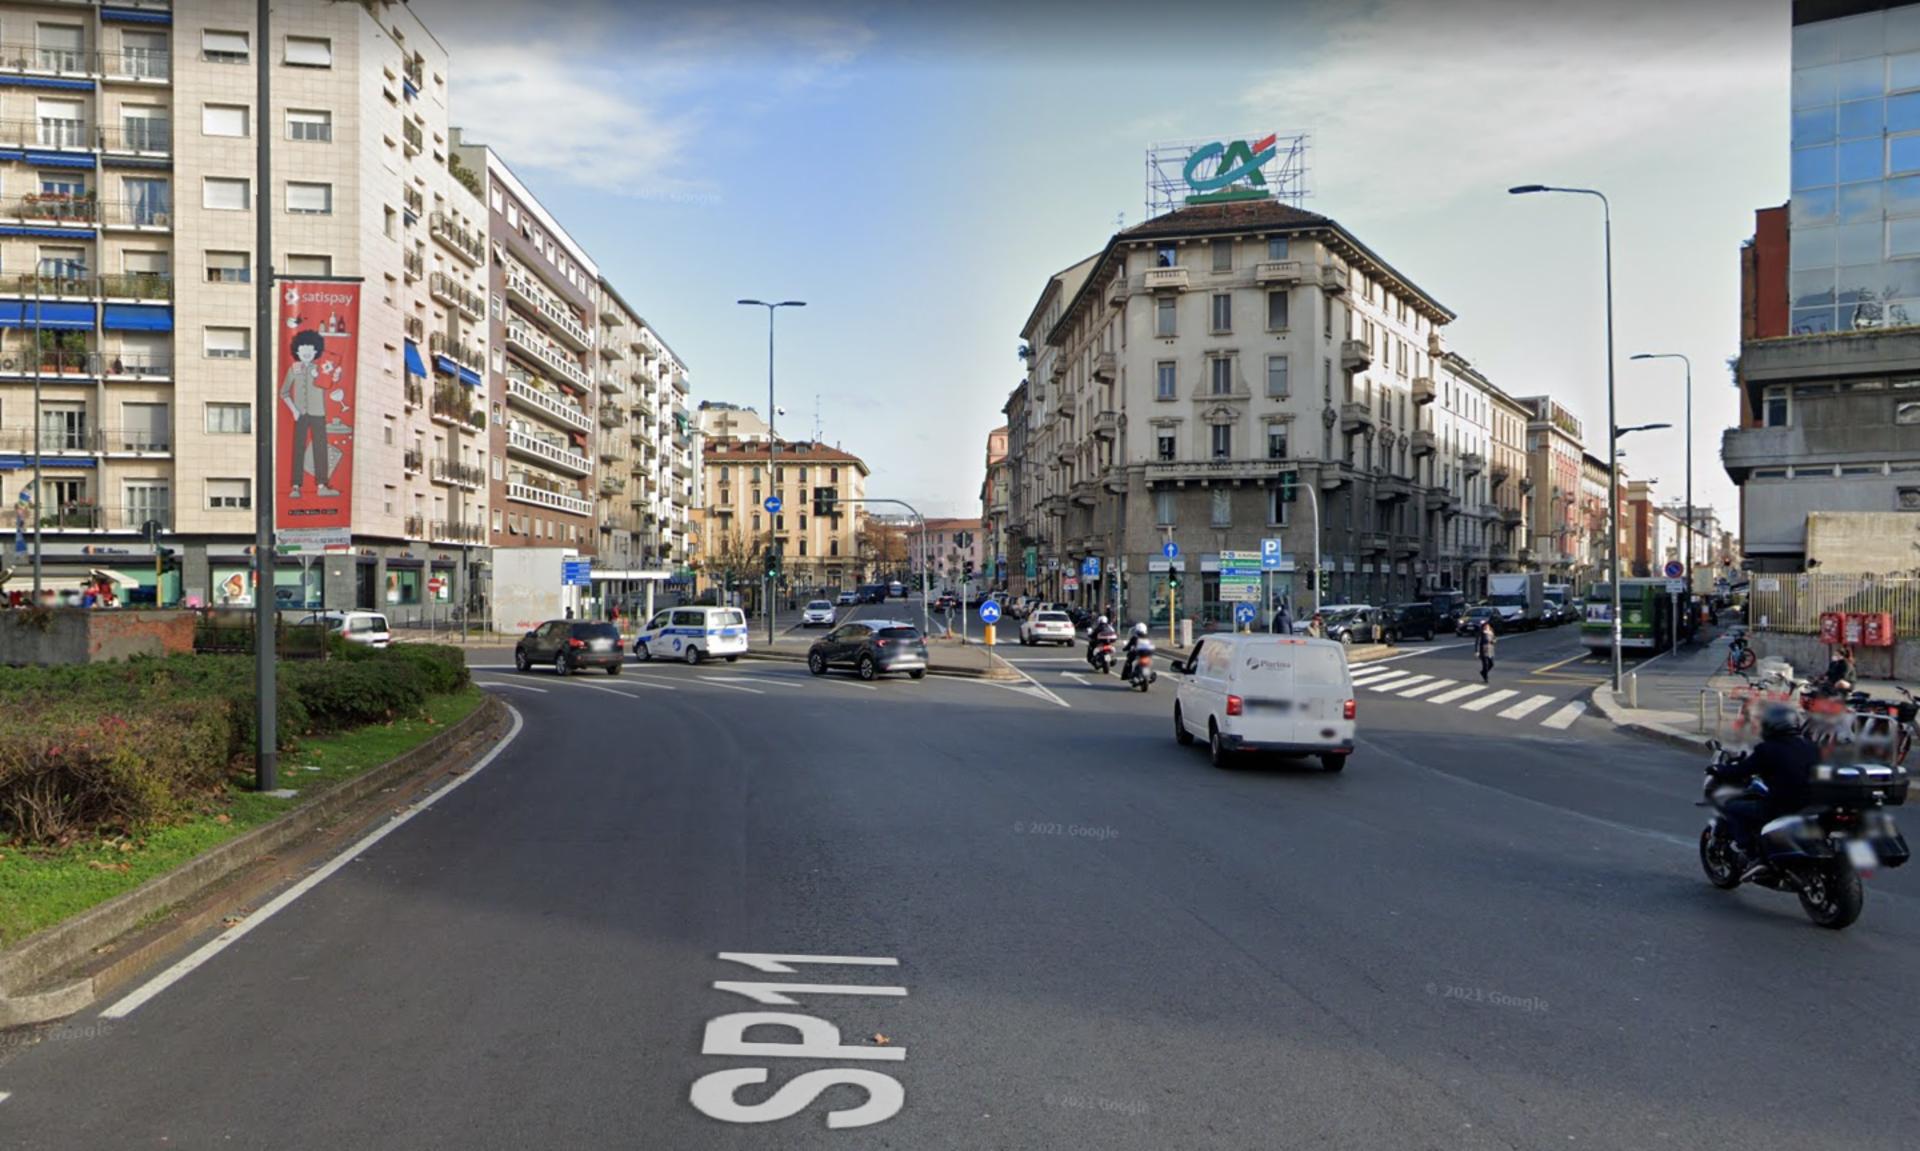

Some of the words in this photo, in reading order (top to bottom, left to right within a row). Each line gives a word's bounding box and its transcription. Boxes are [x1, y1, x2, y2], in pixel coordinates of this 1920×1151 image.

[1183, 133, 1276, 191] CA
[303, 291, 353, 307] satispay
[1265, 541, 1278, 556] P
[689, 951, 908, 1129] SP11
